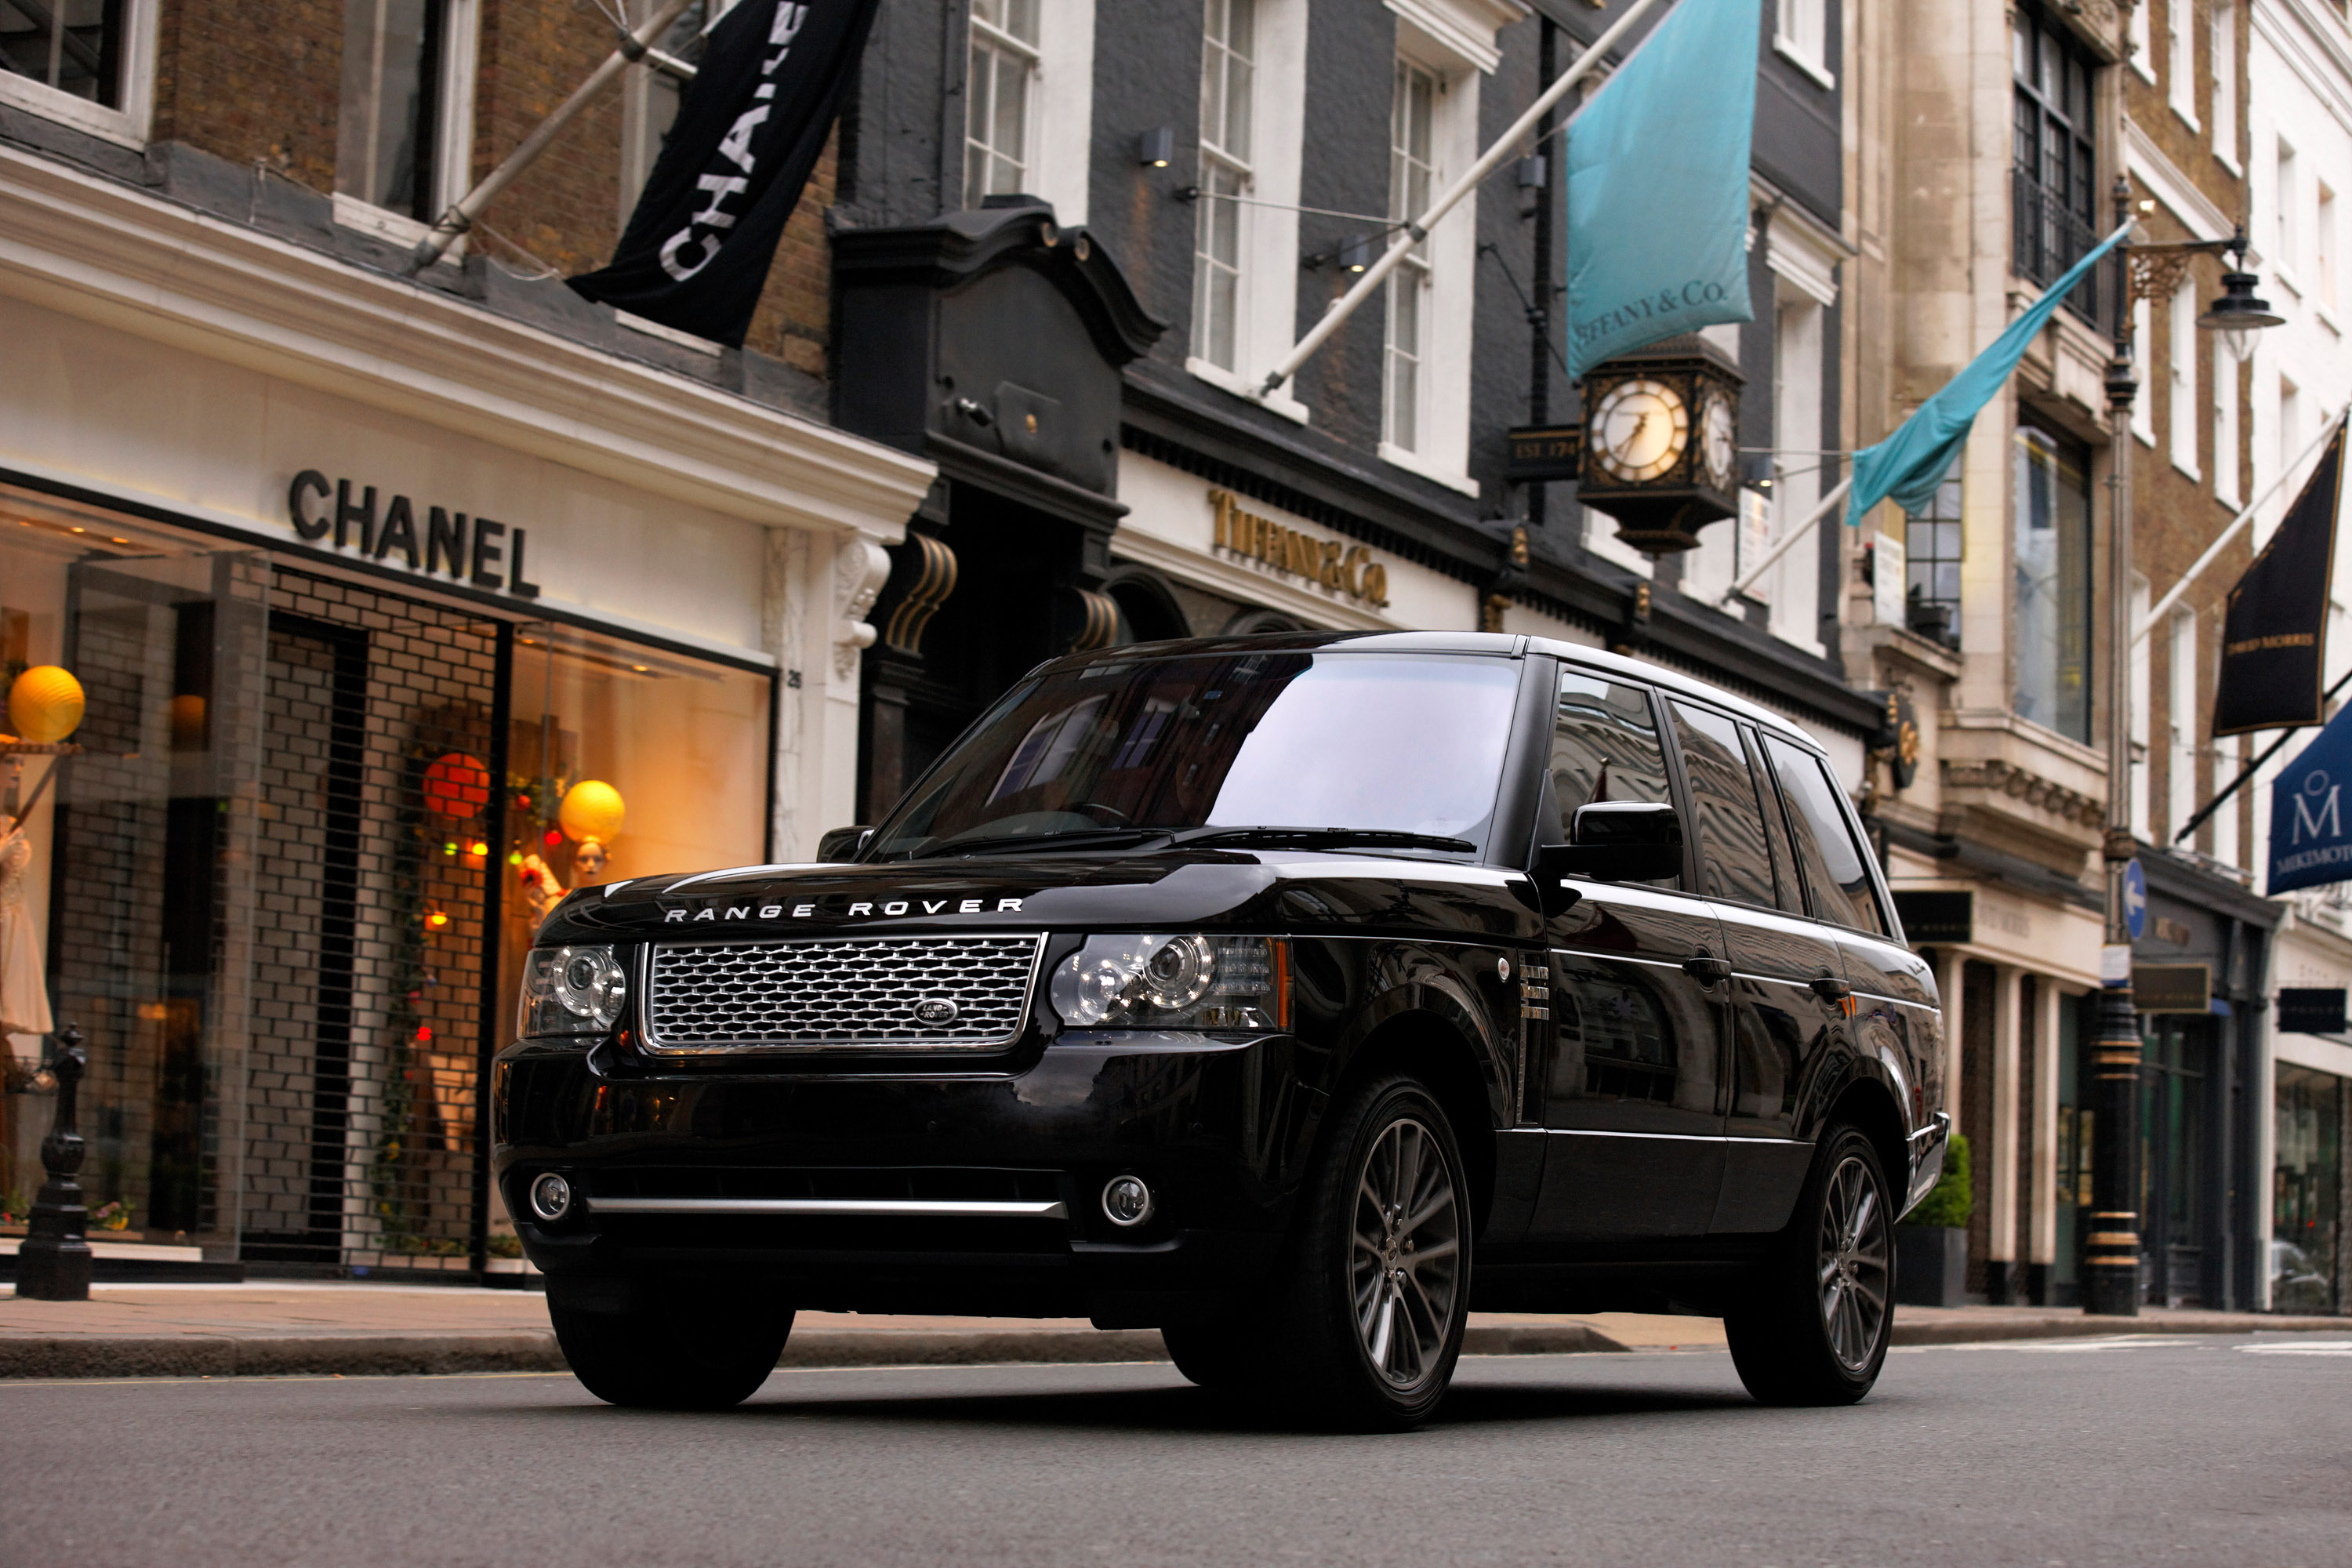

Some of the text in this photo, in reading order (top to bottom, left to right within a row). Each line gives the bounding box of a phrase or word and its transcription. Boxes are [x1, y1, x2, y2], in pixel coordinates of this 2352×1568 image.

[289, 470, 539, 598] CHANEL
[665, 898, 1023, 923] RANGE ROVER
